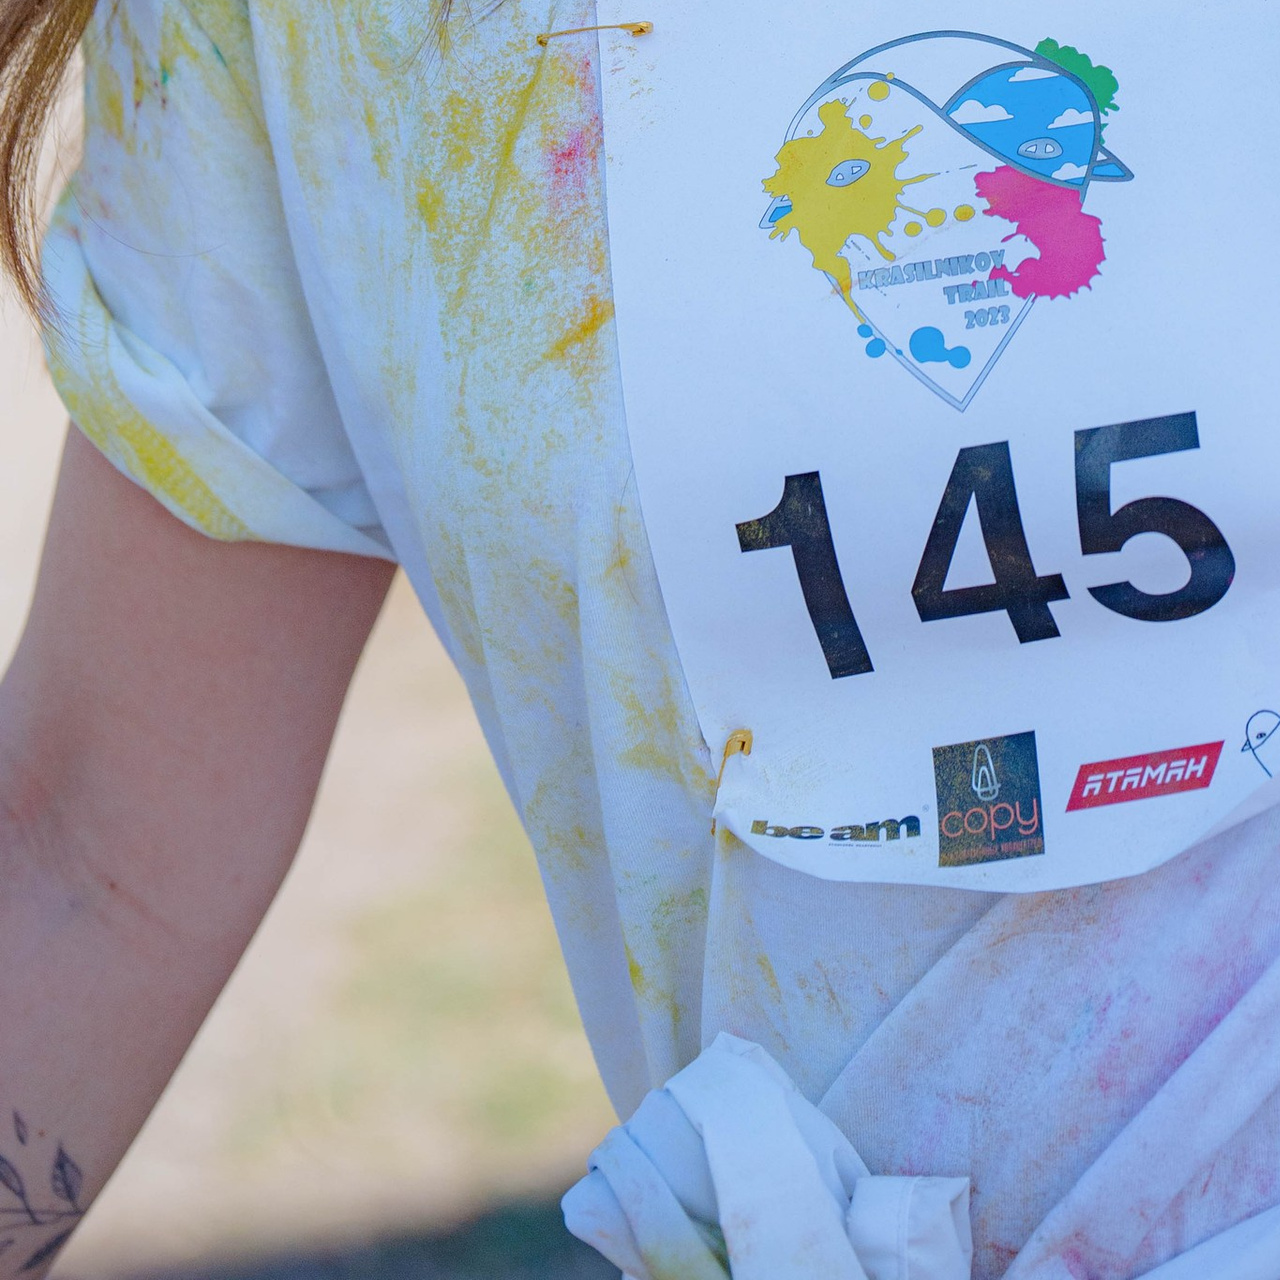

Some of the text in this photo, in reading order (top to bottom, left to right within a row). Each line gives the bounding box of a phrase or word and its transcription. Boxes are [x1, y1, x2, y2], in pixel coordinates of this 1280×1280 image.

[857, 248, 1006, 291] KRASILNIKOV
[942, 278, 1010, 305] TRAIL
[964, 304, 1011, 330] 2023
[734, 410, 1237, 680] 145
[941, 798, 1039, 841] copy
